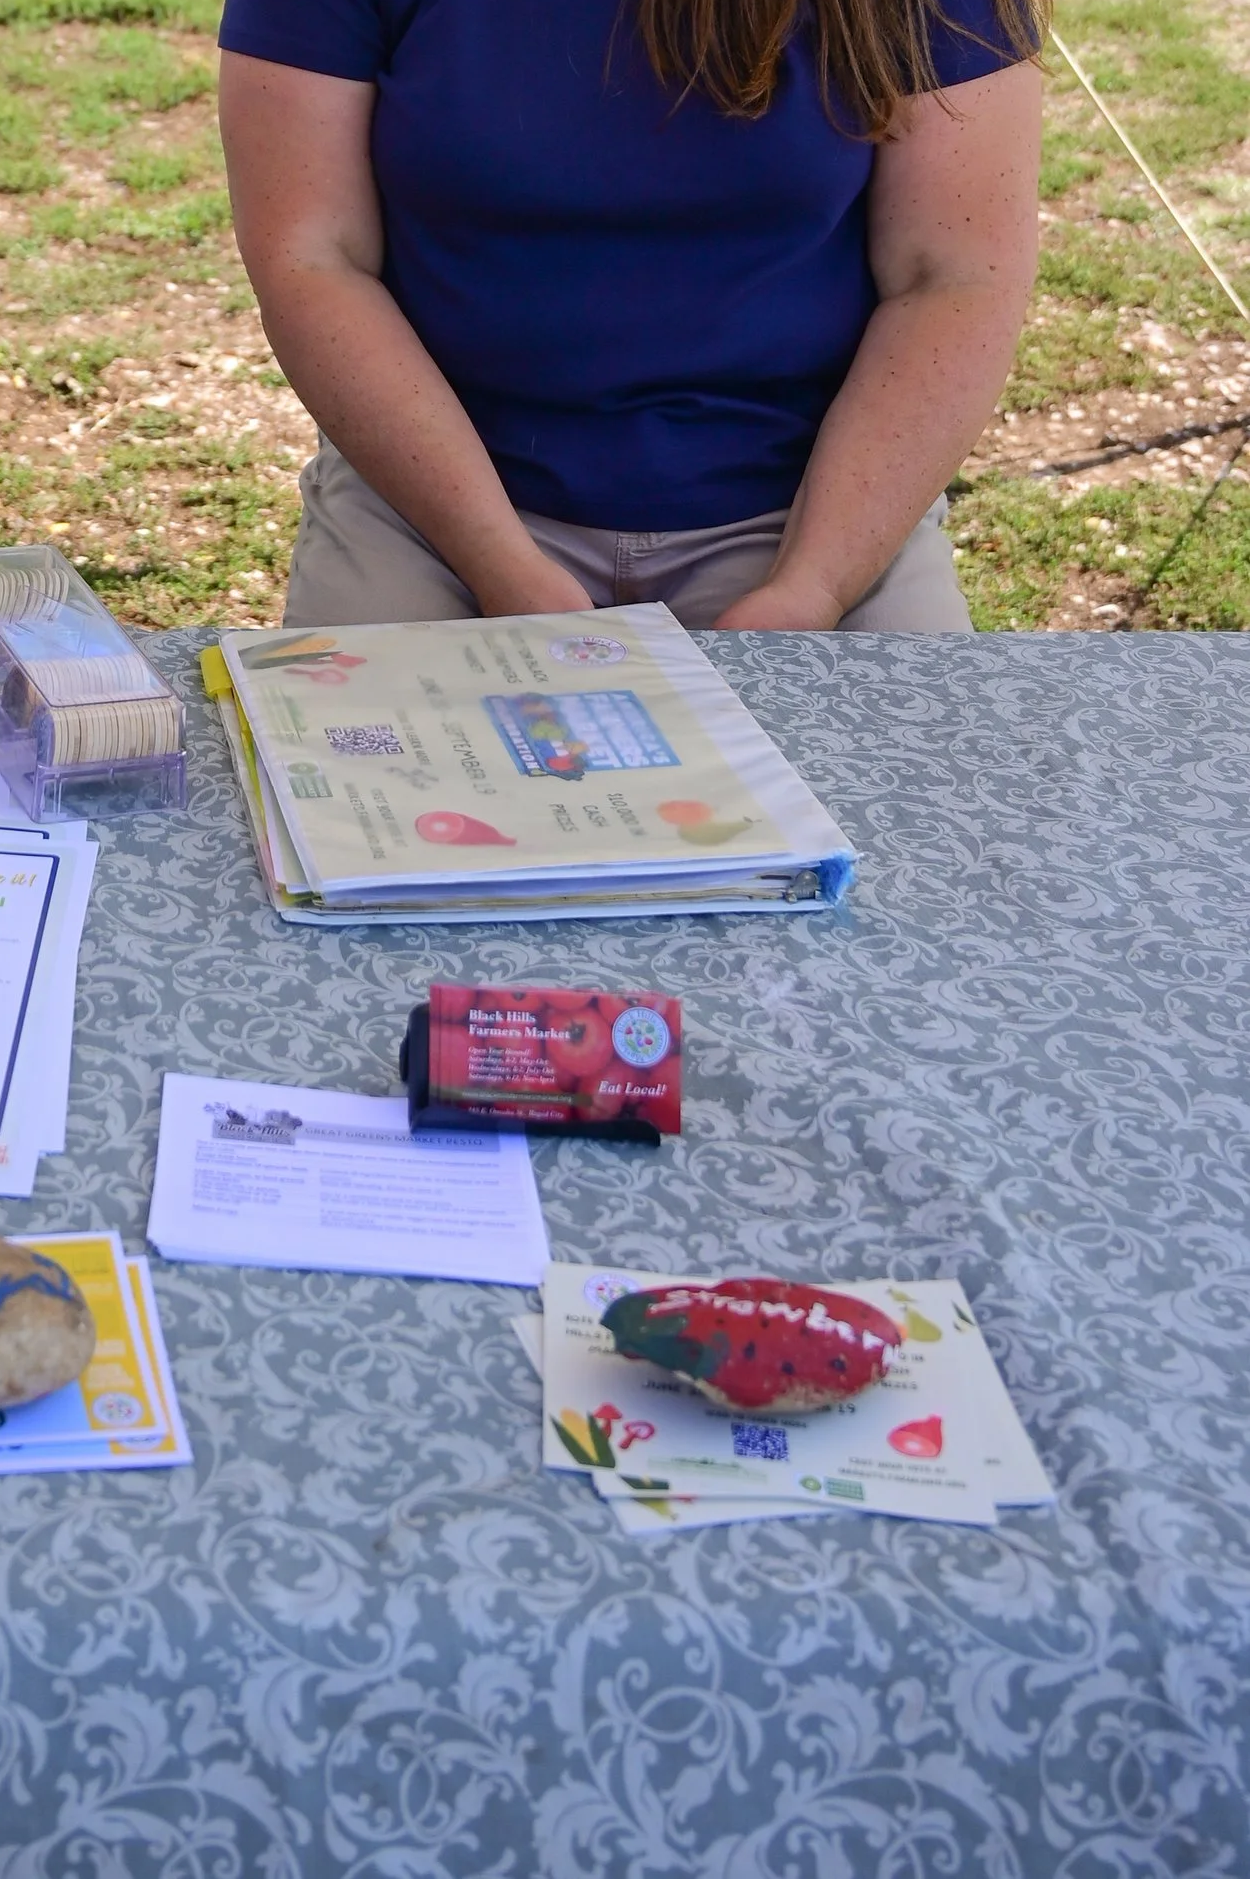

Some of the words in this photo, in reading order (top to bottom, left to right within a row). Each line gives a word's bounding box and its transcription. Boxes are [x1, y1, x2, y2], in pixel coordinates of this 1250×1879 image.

[469, 1009, 504, 1023] Black
[506, 1010, 537, 1023] Hills
[468, 1024, 522, 1039] Farmers
[524, 1027, 571, 1041] Market
[598, 1081, 621, 1095] Eat
[624, 1082, 668, 1097] Local!
